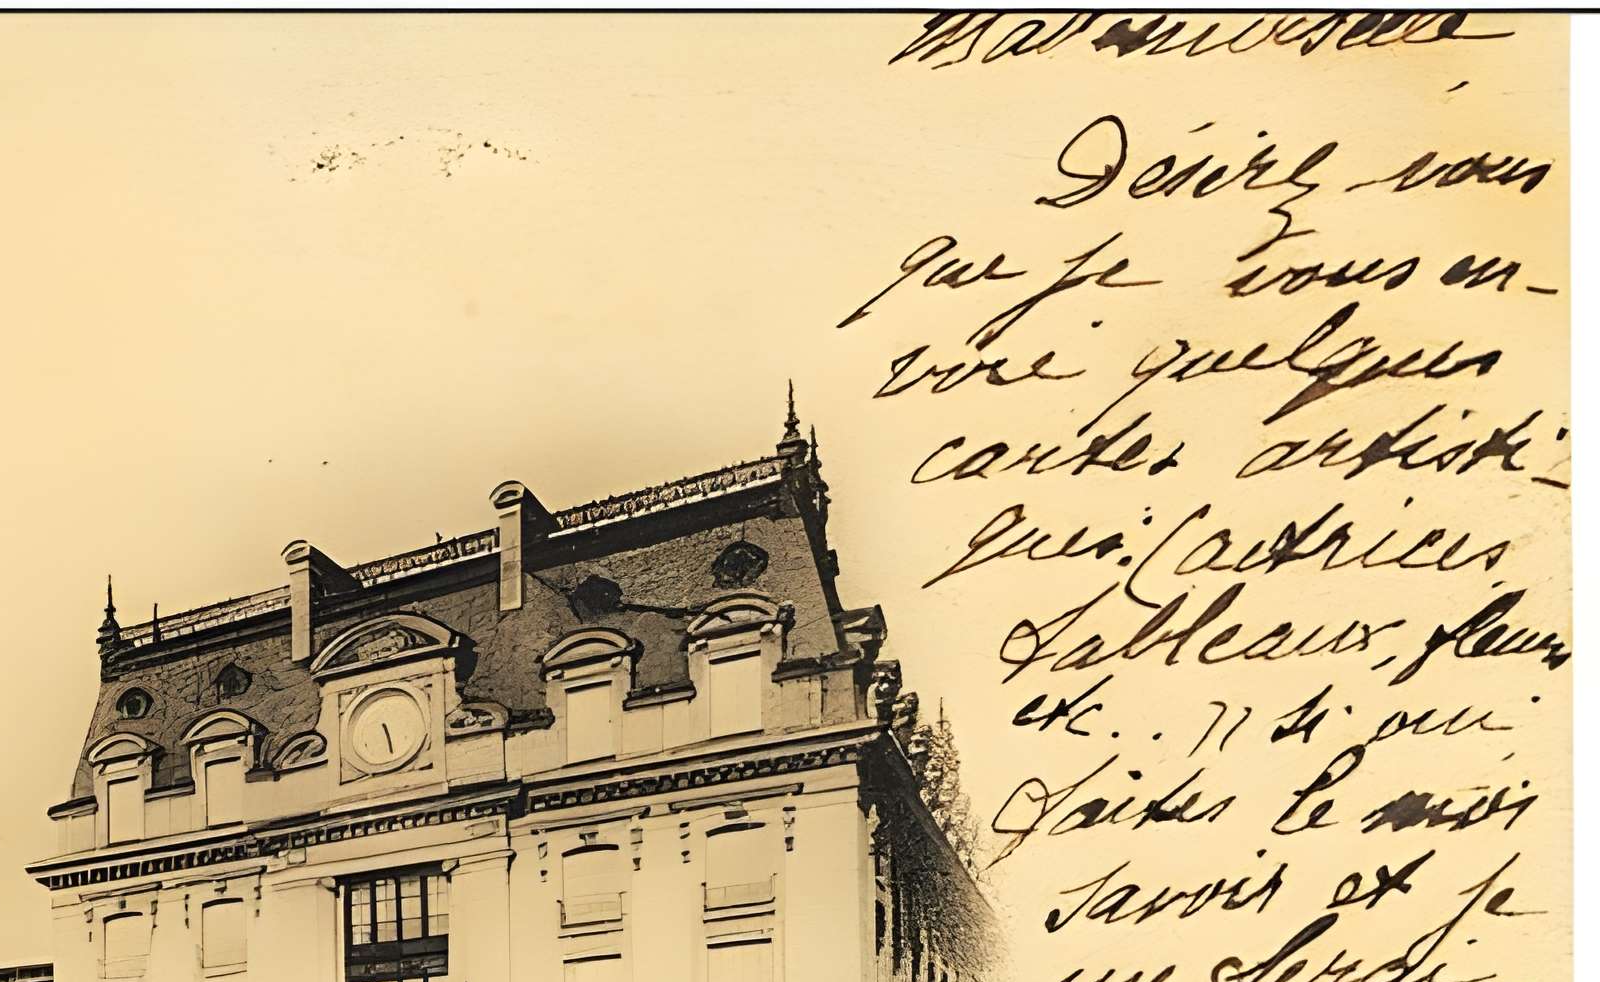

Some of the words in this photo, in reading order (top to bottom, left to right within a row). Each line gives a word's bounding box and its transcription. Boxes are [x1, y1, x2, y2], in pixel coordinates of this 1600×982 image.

[837, 235, 1027, 329] que
[975, 231, 1163, 352] je
[1225, 256, 1421, 298] vous
[1078, 302, 1501, 437] quelques
[911, 412, 1183, 485] cartes
[1326, 850, 1436, 909] et
